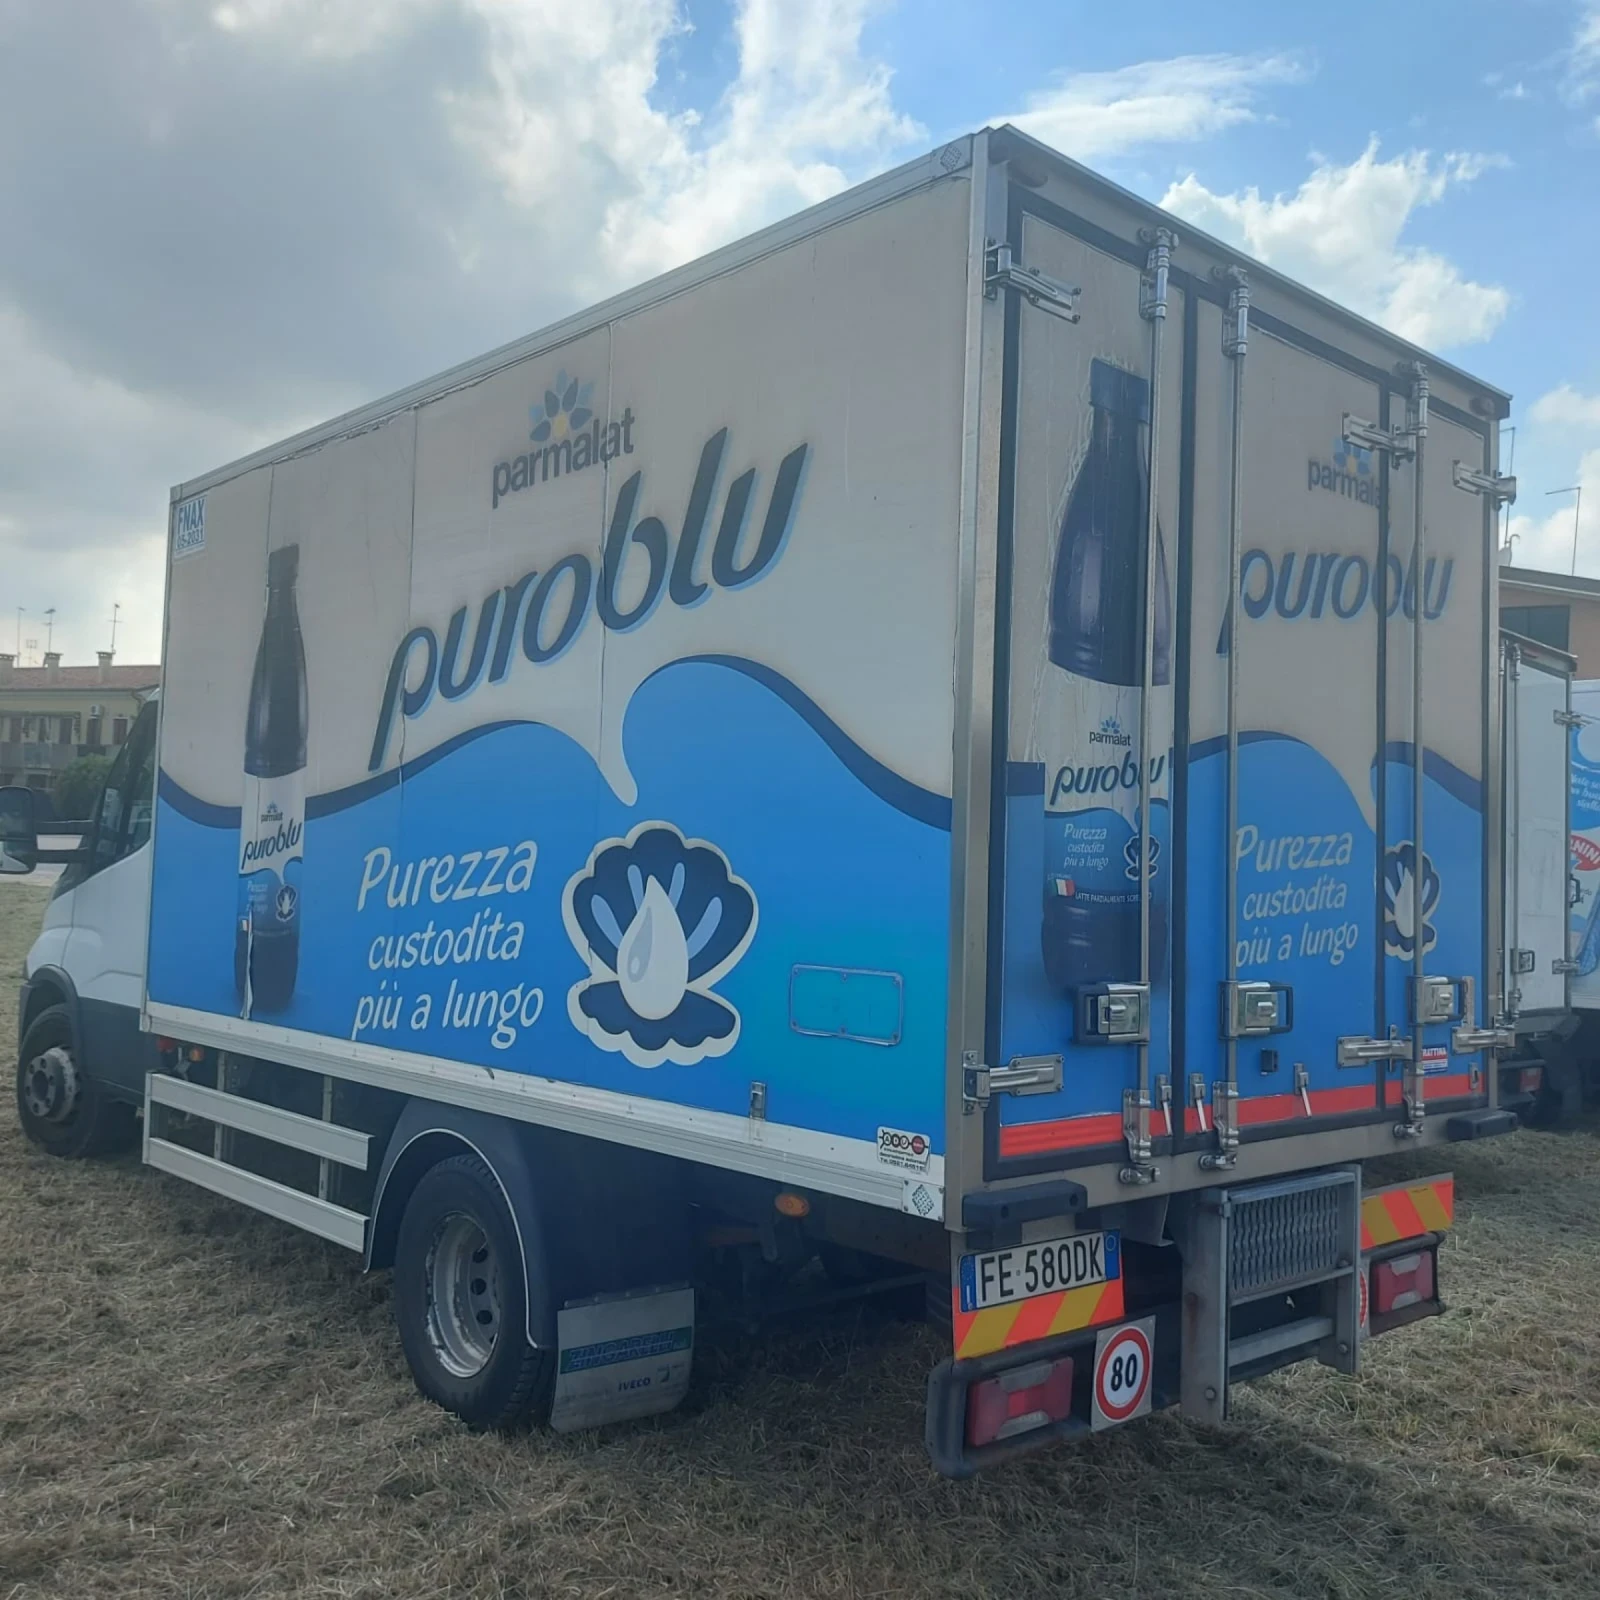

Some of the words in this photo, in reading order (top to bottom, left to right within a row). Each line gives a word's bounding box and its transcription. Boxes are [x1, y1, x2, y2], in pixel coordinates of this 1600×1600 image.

[492, 407, 635, 510] parmalat
[369, 428, 809, 773] puroblu
[1089, 731, 1131, 746] parmalat
[241, 818, 302, 870] puroblu
[1064, 823, 1107, 840] Purezza
[1236, 824, 1353, 873] Purezza
[357, 840, 538, 912] Purezza
[1243, 874, 1347, 921] custodita
[368, 906, 525, 970] custodita
[1277, 934, 1292, 961] a
[1300, 921, 1358, 966] lungo
[351, 979, 402, 1041] più
[410, 993, 431, 1030] a
[442, 978, 544, 1049] lungo
[980, 1253, 1014, 1302] FE
[1024, 1236, 1105, 1293] 580DK
[618, 1377, 651, 1392] IVECO
[1110, 1353, 1138, 1392] 80
